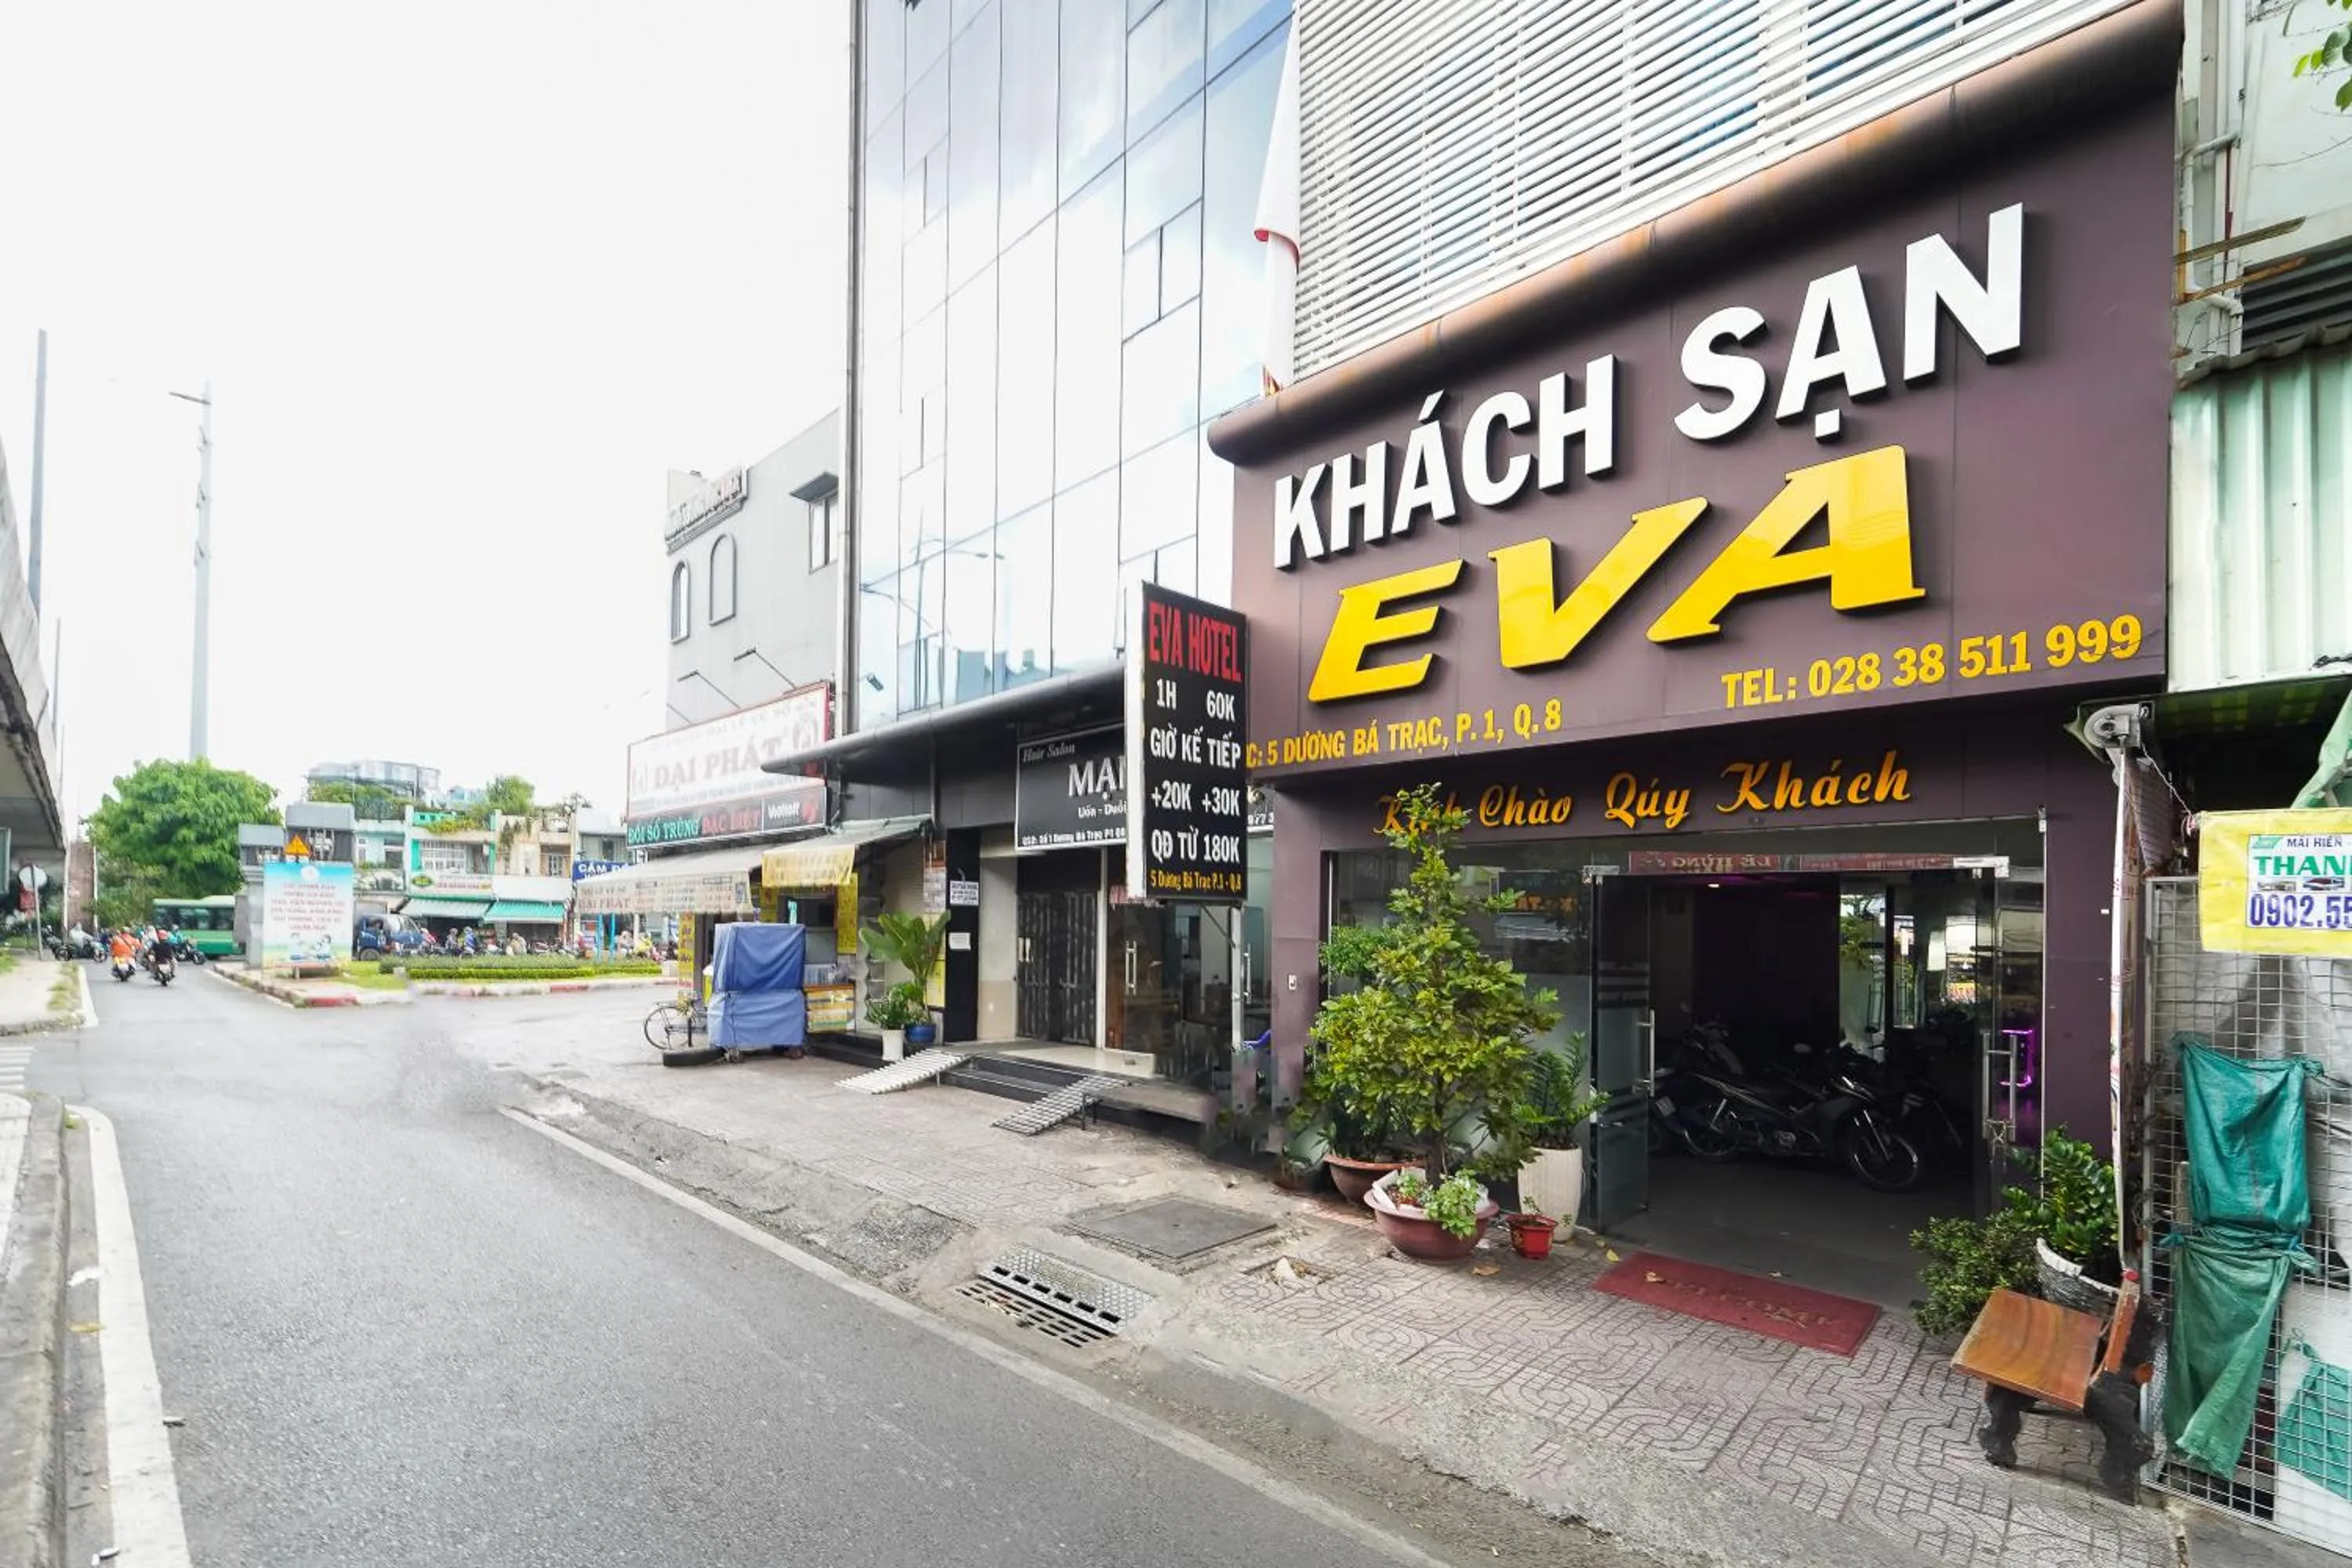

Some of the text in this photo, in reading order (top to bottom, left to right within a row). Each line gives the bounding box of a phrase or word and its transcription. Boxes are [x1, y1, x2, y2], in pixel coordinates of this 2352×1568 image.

[1275, 202, 2024, 568] KHÁCH SẠN
[1308, 445, 1926, 702] EVA
[1149, 601, 1243, 682] EVA HOTEL
[1721, 615, 2142, 708] TEL: 028 38 511 999
[1156, 678, 1236, 722] 1H 60K
[1150, 723, 1241, 769] GIỜ KẾ TIẾP
[1267, 739, 1278, 765] 5
[1352, 719, 1380, 756] BÁ
[1151, 780, 1240, 816] +20K +30K
[1479, 785, 1572, 828] Chào
[1604, 772, 1693, 829] Qúy
[1715, 750, 1911, 812] Khách
[1151, 829, 1174, 862] QĐ
[1203, 833, 1240, 862] 180K
[2253, 855, 2352, 876] THAN
[1150, 869, 1156, 887] 5
